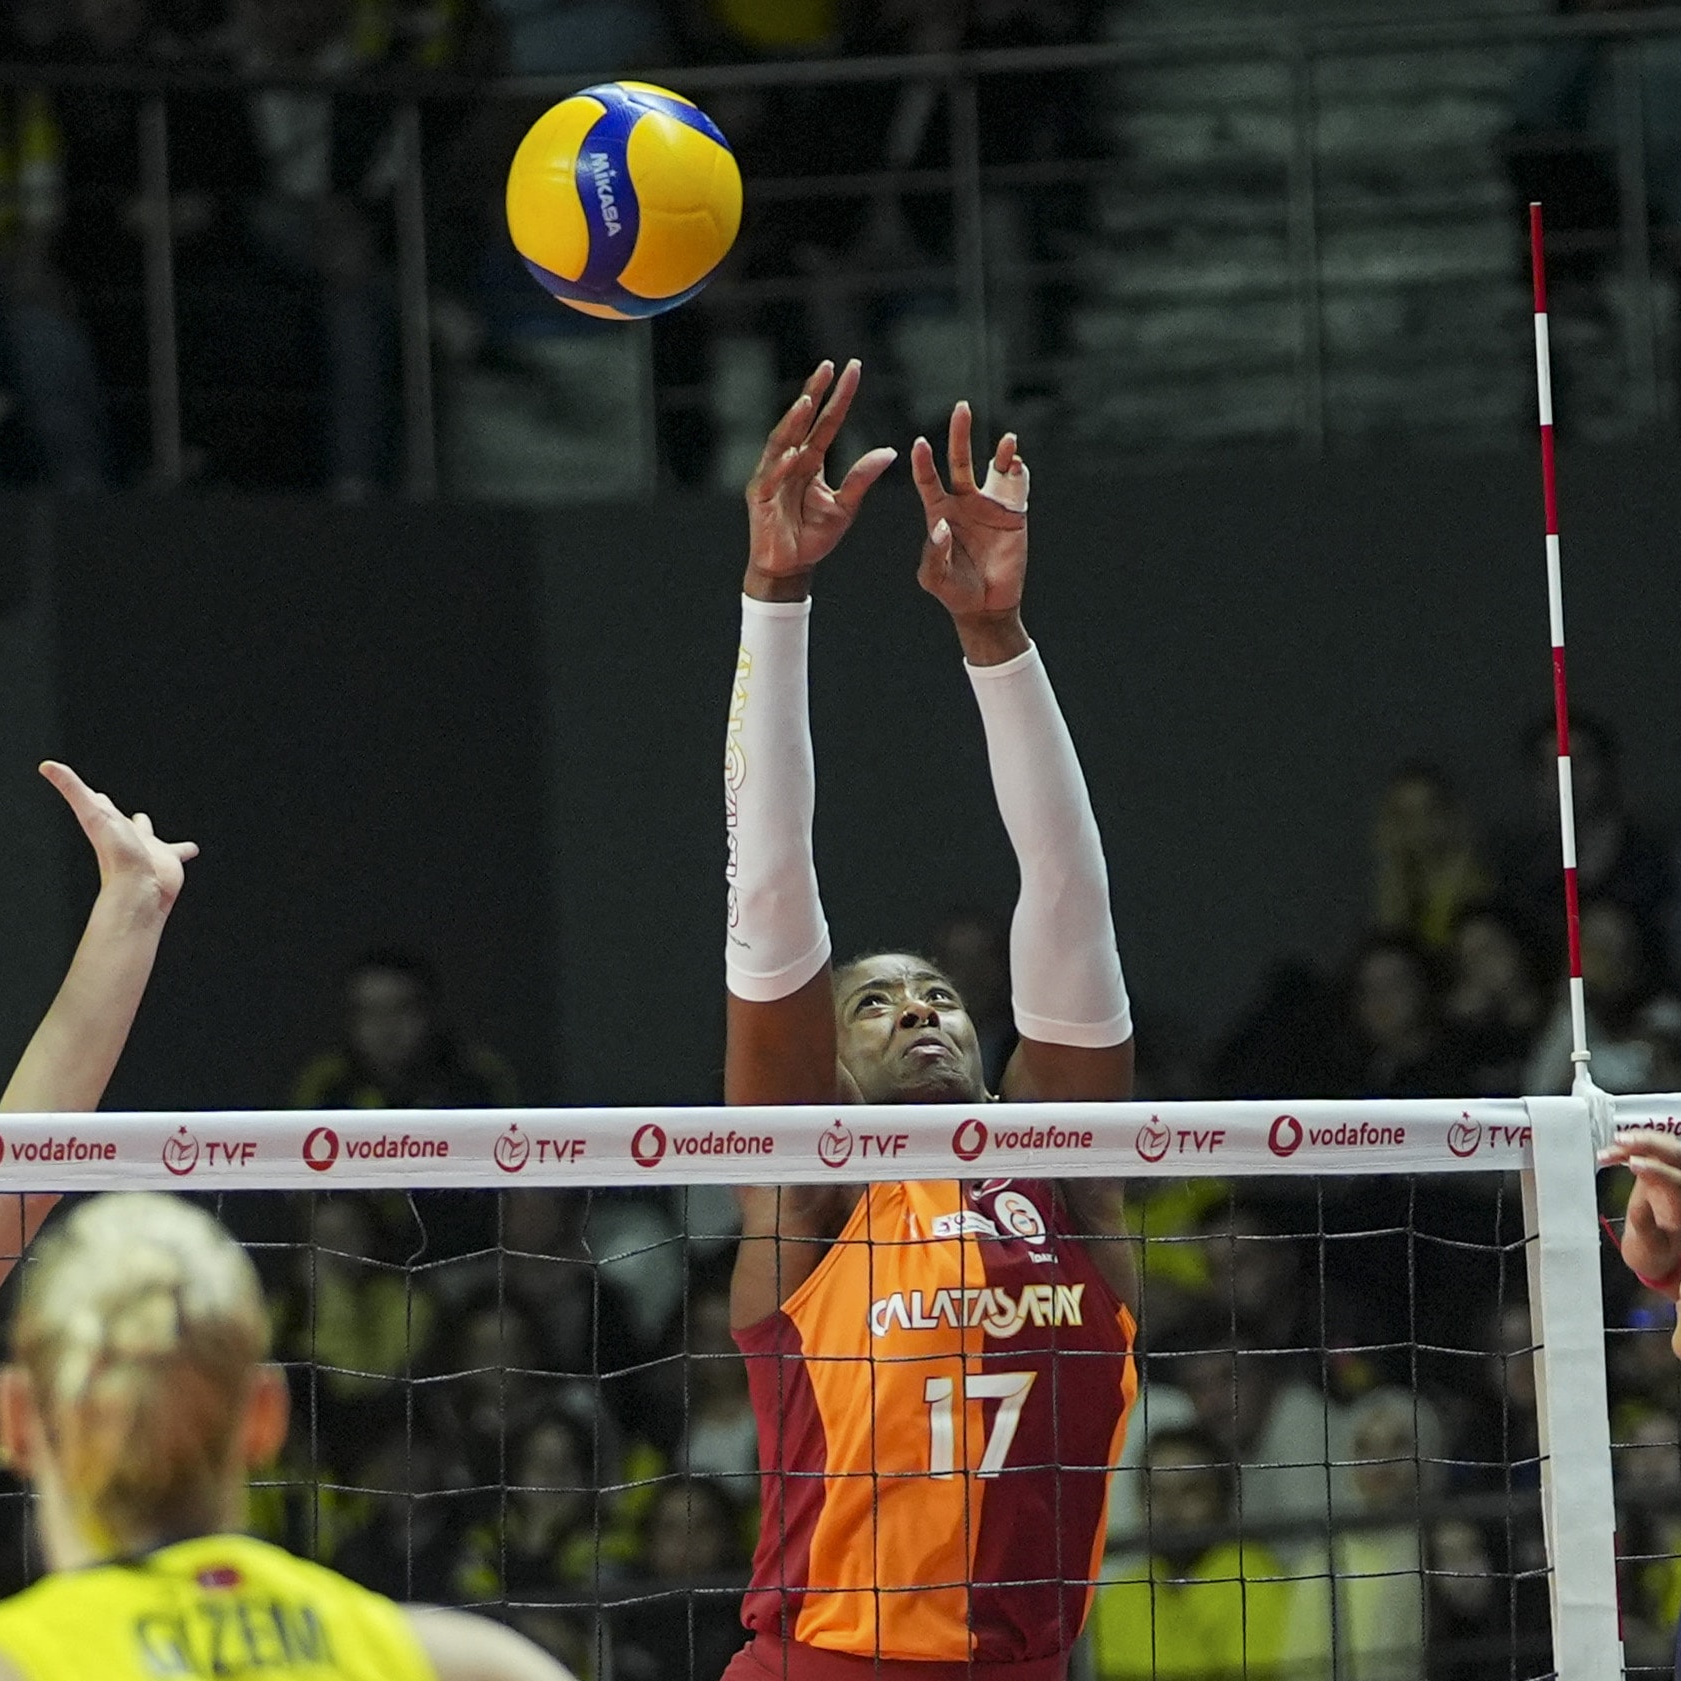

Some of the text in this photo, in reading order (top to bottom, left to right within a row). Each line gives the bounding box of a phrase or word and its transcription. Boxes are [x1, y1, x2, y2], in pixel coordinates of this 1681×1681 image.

[11, 1136, 118, 1163] vodafone
[206, 1141, 258, 1168] TVF
[346, 1134, 450, 1160] vodafone
[536, 1138, 587, 1164] TVF
[672, 1130, 775, 1157] vodafone
[859, 1133, 910, 1159] TVF
[993, 1125, 1094, 1151] vodafone
[1177, 1129, 1226, 1155] TVF
[1308, 1122, 1405, 1148] vodafone
[924, 1371, 1038, 1481] 17
